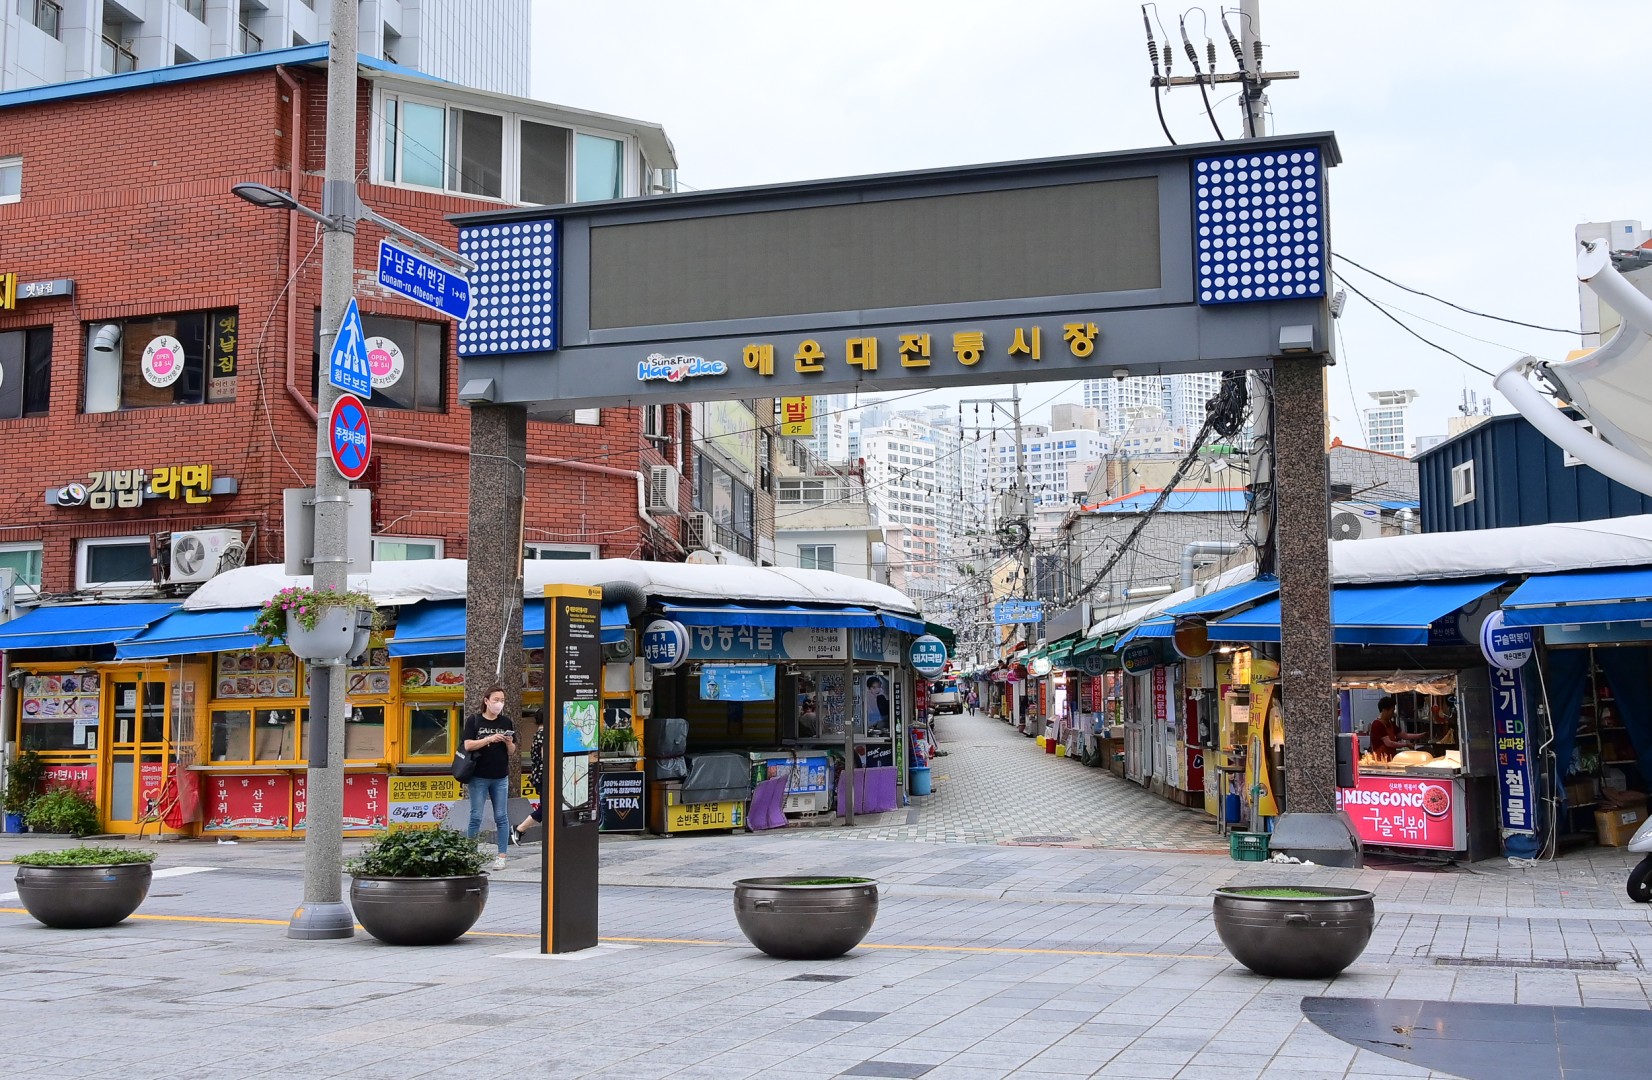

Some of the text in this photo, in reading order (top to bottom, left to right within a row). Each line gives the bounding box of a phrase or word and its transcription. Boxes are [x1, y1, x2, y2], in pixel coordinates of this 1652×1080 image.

[25, 281, 53, 298] 옛날집
[381, 270, 445, 308] Gunam-ro 41beon-gil
[217, 316, 237, 373] 옛날집
[652, 356, 696, 367] Sun&Fun
[334, 368, 368, 393] 횡단보도
[335, 426, 368, 448] 주정차금지
[791, 425, 802, 433] 2F
[1494, 631, 1532, 647] 구슬떡볶이
[644, 643, 676, 660] 냉동식품
[913, 653, 943, 664] 돼지국밥
[1497, 719, 1525, 735] LED
[1497, 737, 1525, 751] 삼파장
[393, 780, 454, 791] 20년전통 곰장어
[393, 791, 454, 800] 원조 연탄구이 전문집
[606, 797, 640, 810] TERRA
[1344, 789, 1423, 808] MISSGONG
[1505, 769, 1526, 826] 철물
[676, 812, 700, 827] 손반죽
[1362, 807, 1428, 841] 구슬떡볶이
